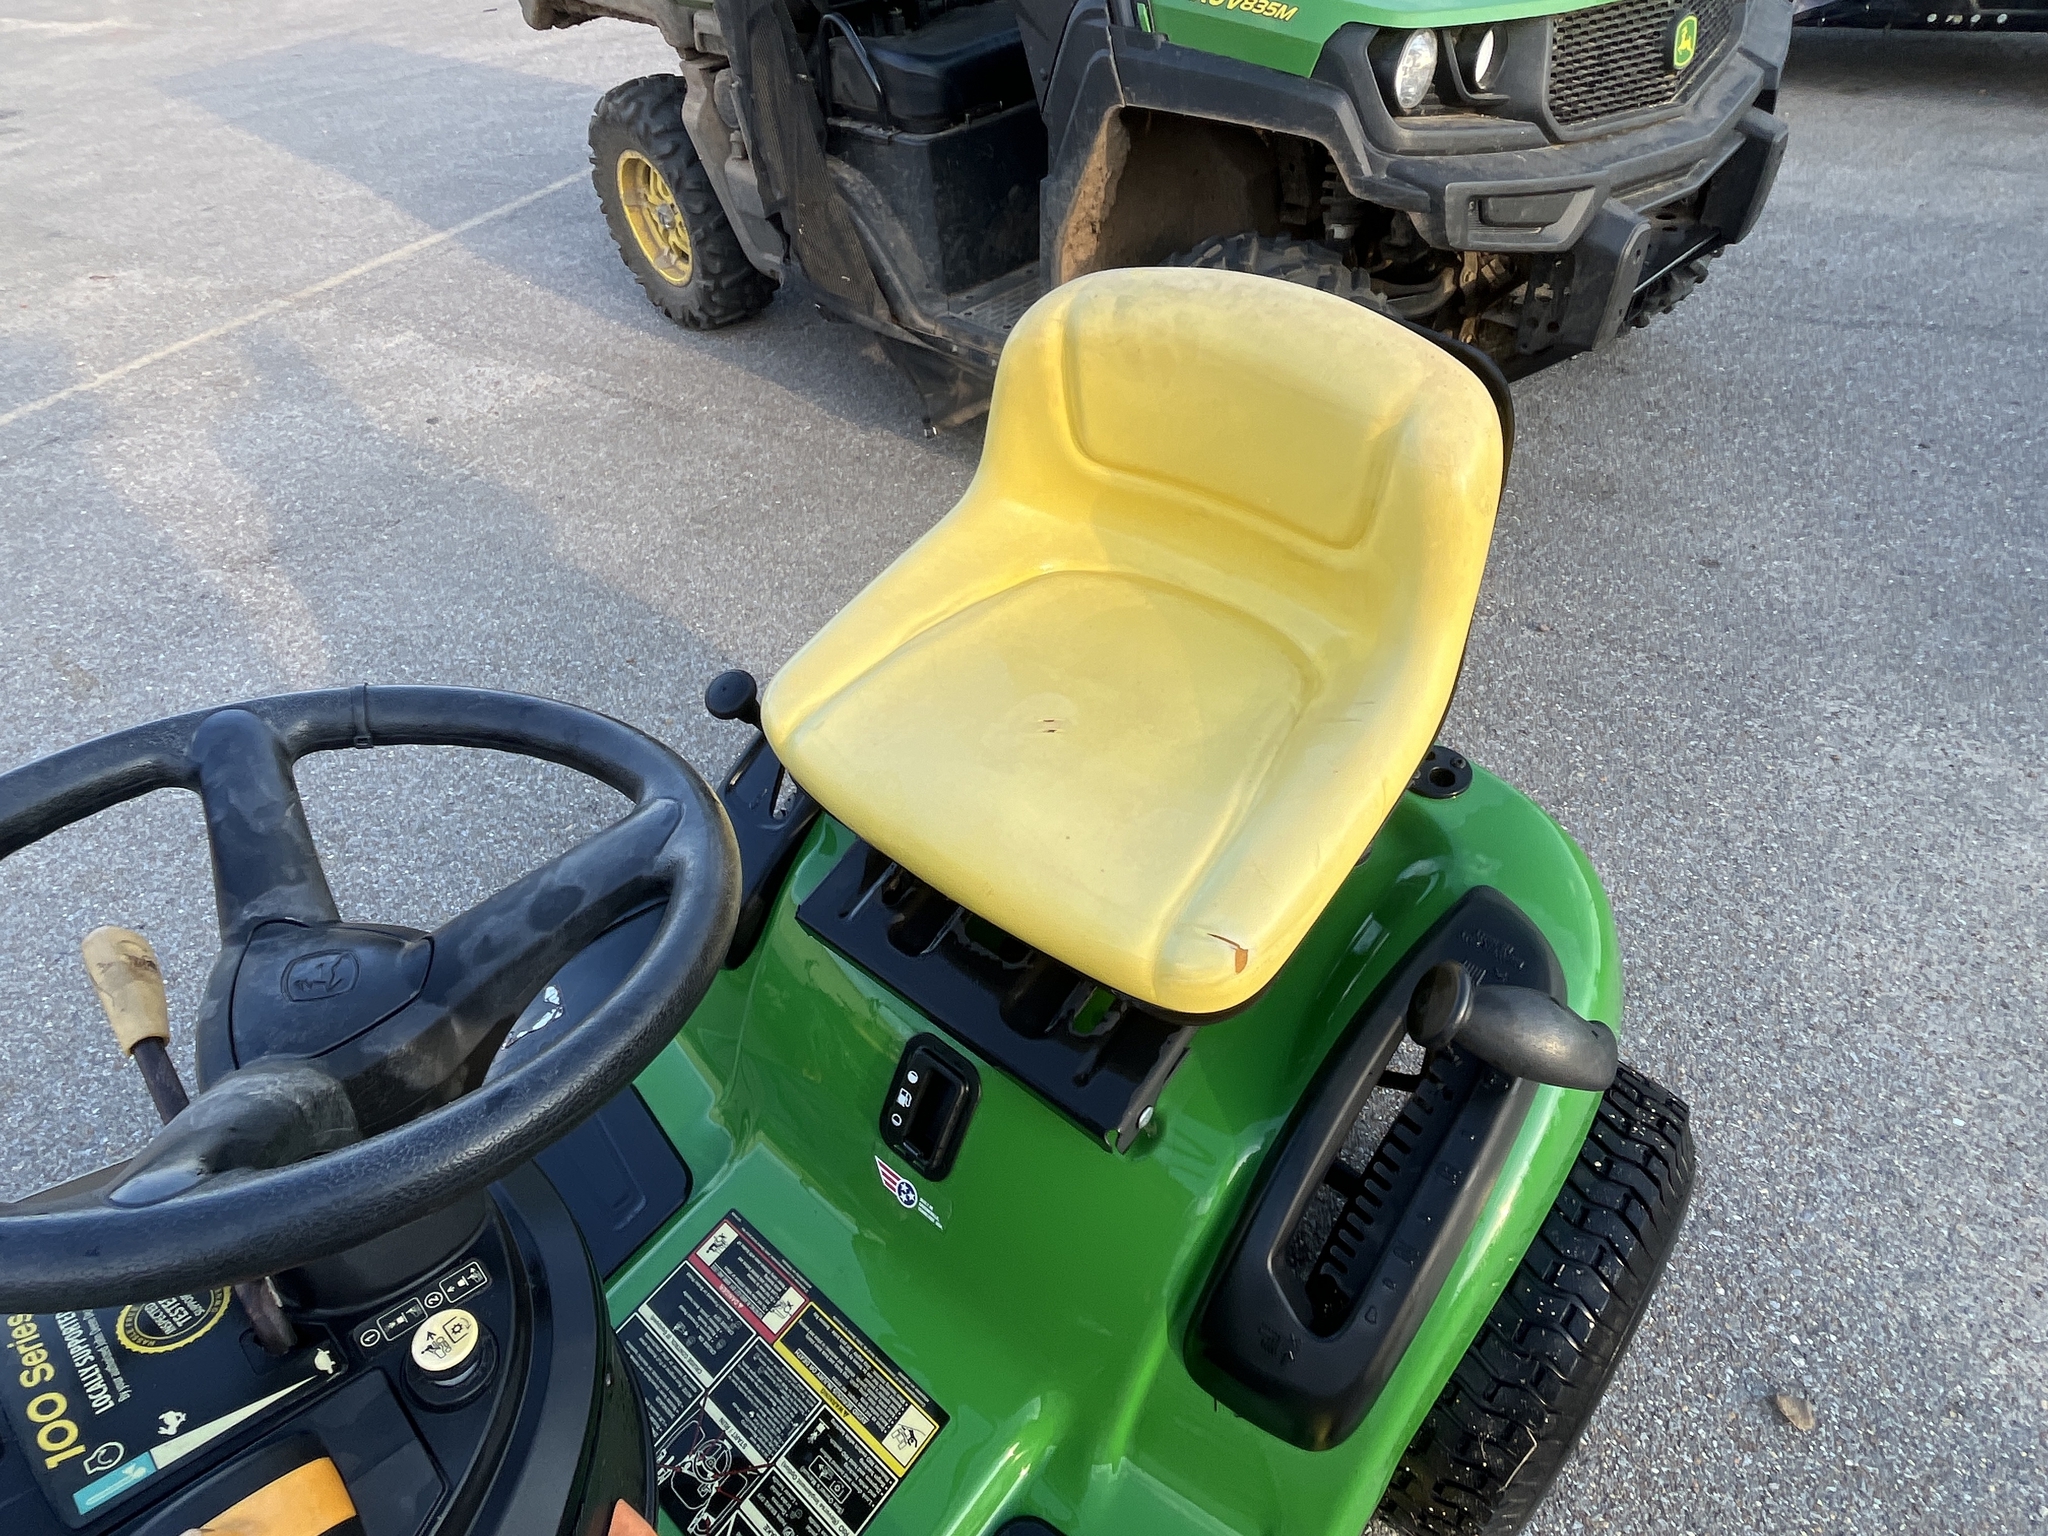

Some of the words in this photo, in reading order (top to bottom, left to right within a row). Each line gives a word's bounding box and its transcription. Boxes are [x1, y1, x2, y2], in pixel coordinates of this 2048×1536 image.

[1190, 0, 1299, 21] V835M
[144, 1302, 177, 1335] INSPECTED
[6, 1313, 56, 1388] Series
[77, 1363, 116, 1416] LOCALLY
[818, 1387, 845, 1413] WARNING
[26, 1391, 87, 1470] 100
[717, 1416, 731, 1430] RUN
[730, 1430, 748, 1449] START
[779, 1460, 798, 1480] Option)
[795, 1477, 820, 1505] Implement
